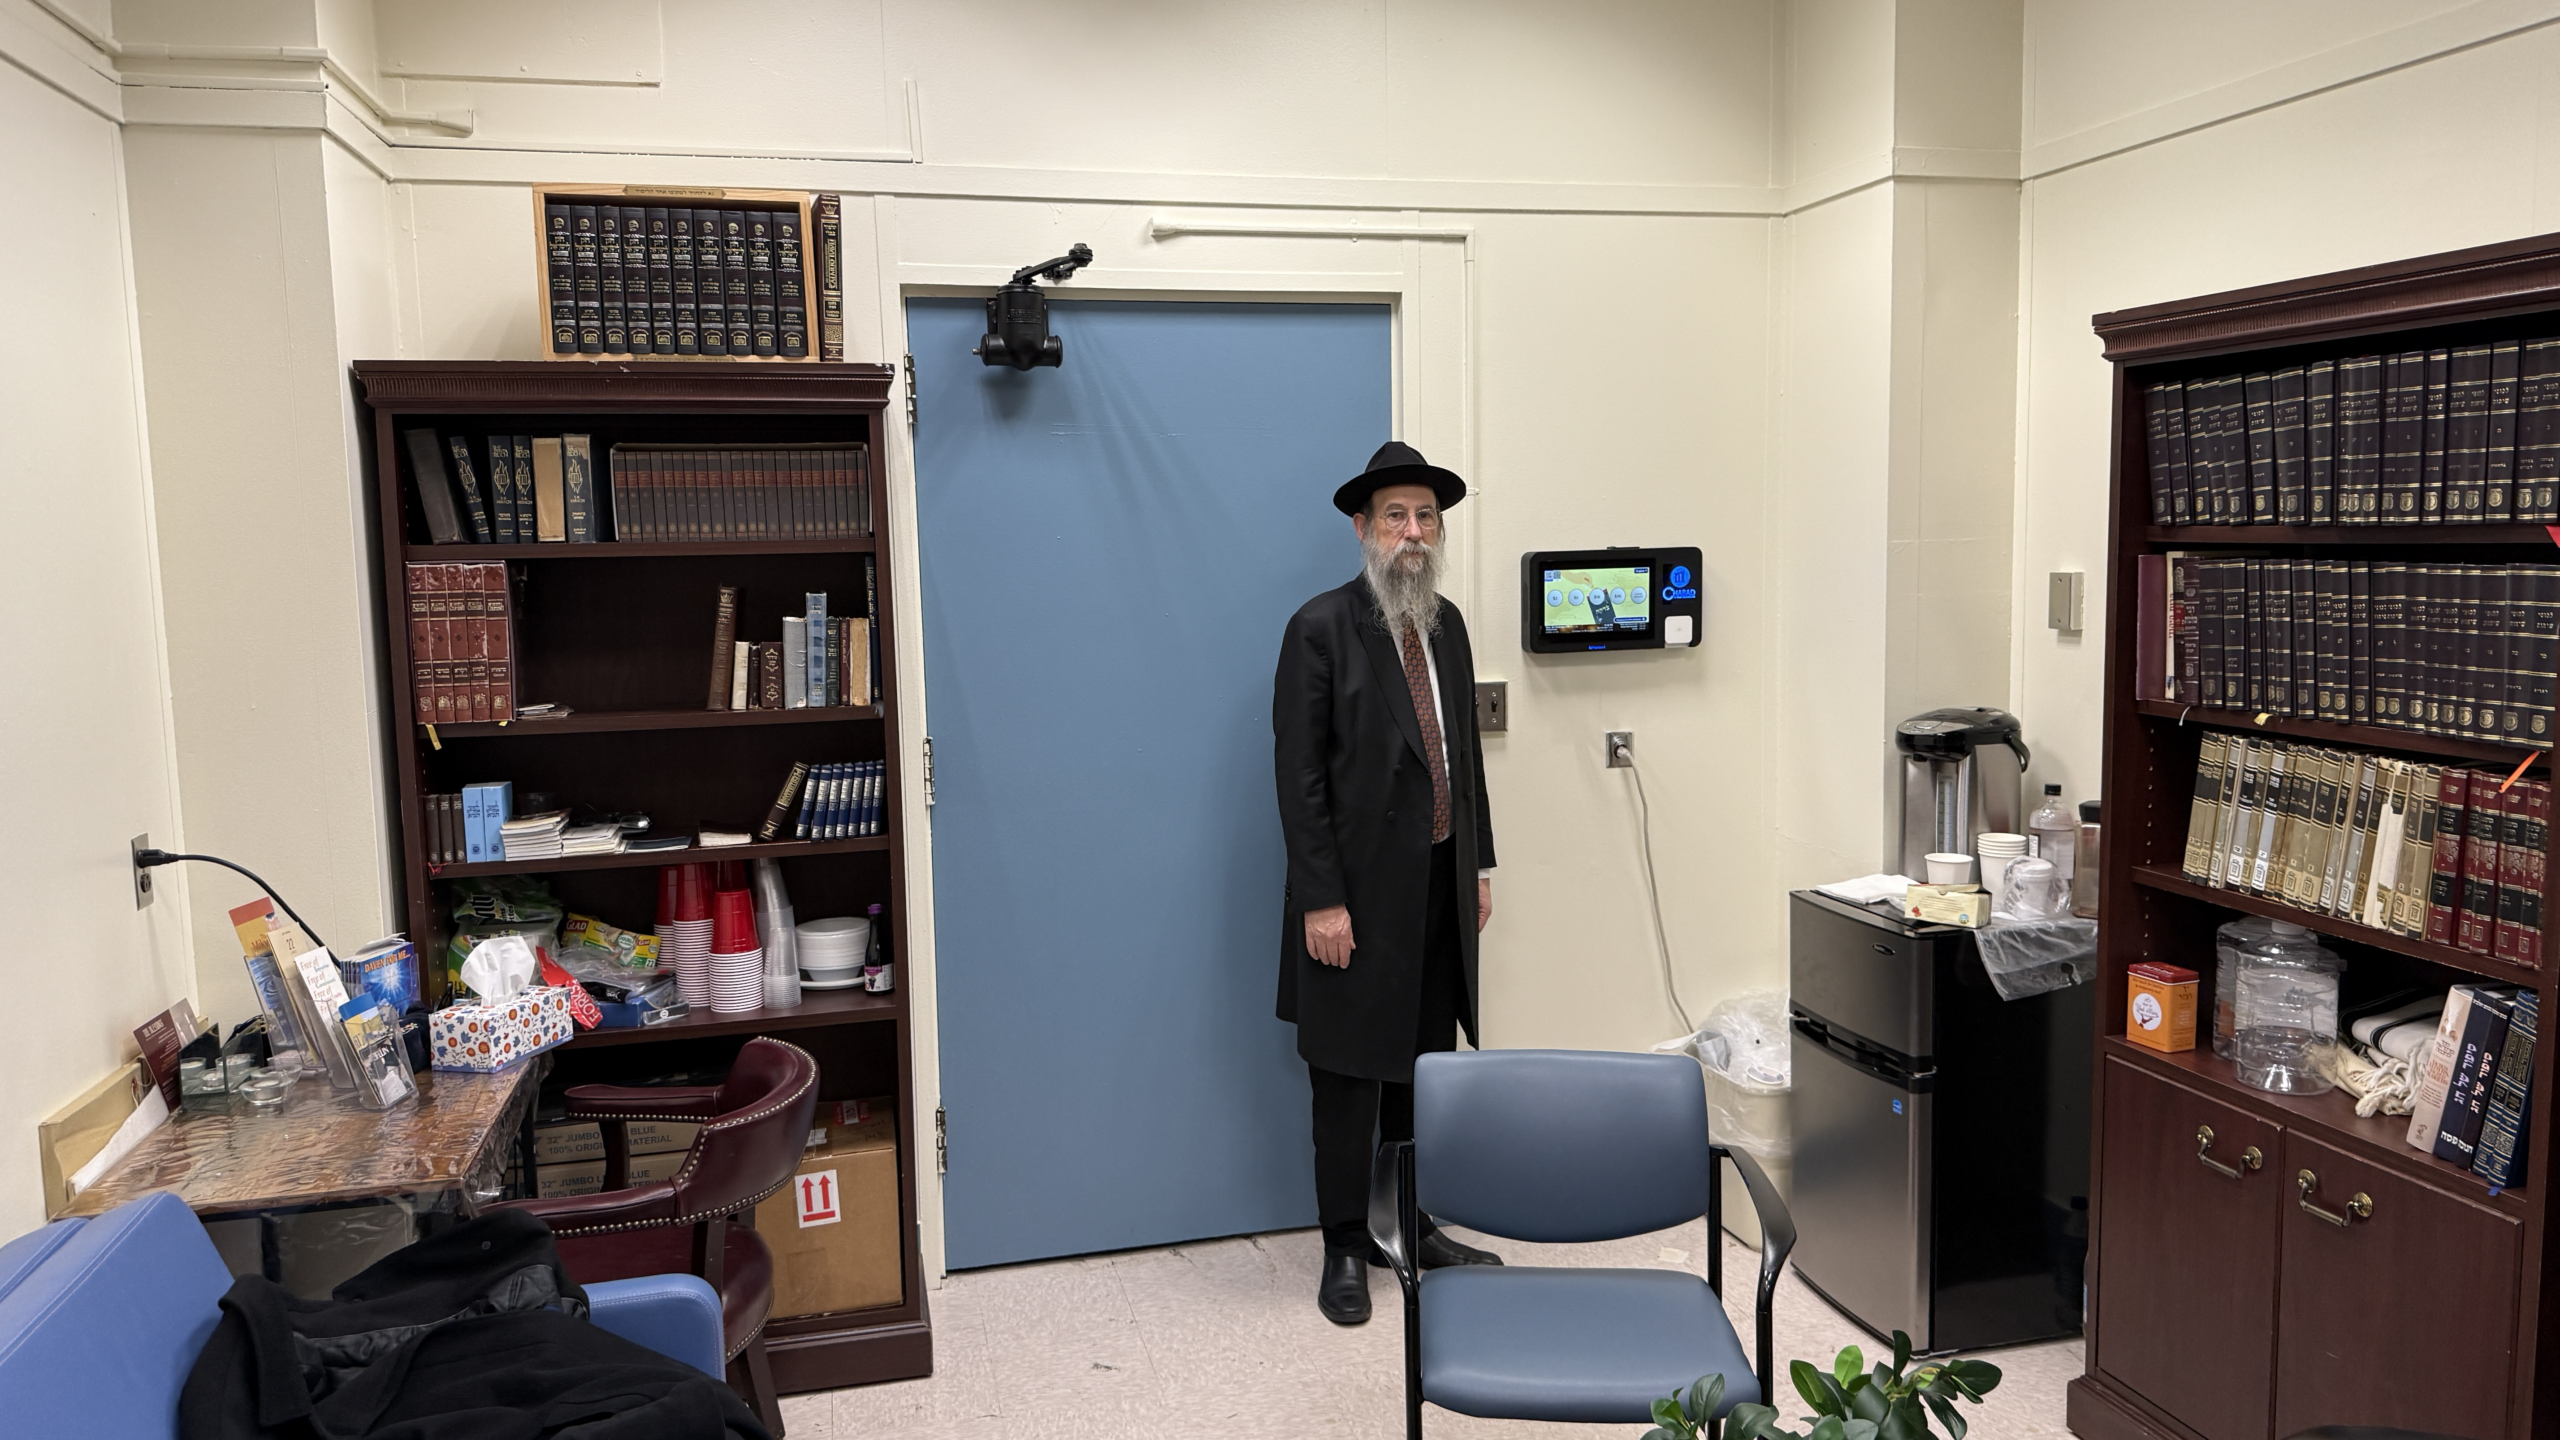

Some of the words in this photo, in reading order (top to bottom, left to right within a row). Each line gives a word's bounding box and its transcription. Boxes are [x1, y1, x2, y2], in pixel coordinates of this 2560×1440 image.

[566, 920, 587, 931] GLAD
[364, 959, 386, 973] DAVEN
[386, 954, 398, 967] FOR
[646, 959, 655, 967] 22
[570, 984, 601, 1022] FORKS
[2462, 1043, 2477, 1068] סיפור
[2478, 1052, 2493, 1077] סיפור
[2453, 1073, 2470, 1089] של
[2470, 1082, 2486, 1097] של
[2453, 1091, 2466, 1105] חג
[2470, 1100, 2481, 1114] חג
[565, 1132, 600, 1142] JUMBO
[630, 1126, 656, 1135] BLUE
[549, 1146, 573, 1155] 100%
[575, 1142, 603, 1151] ORIGI
[560, 1177, 593, 1187] JUMBO
[570, 1186, 602, 1197] ORIGIN
